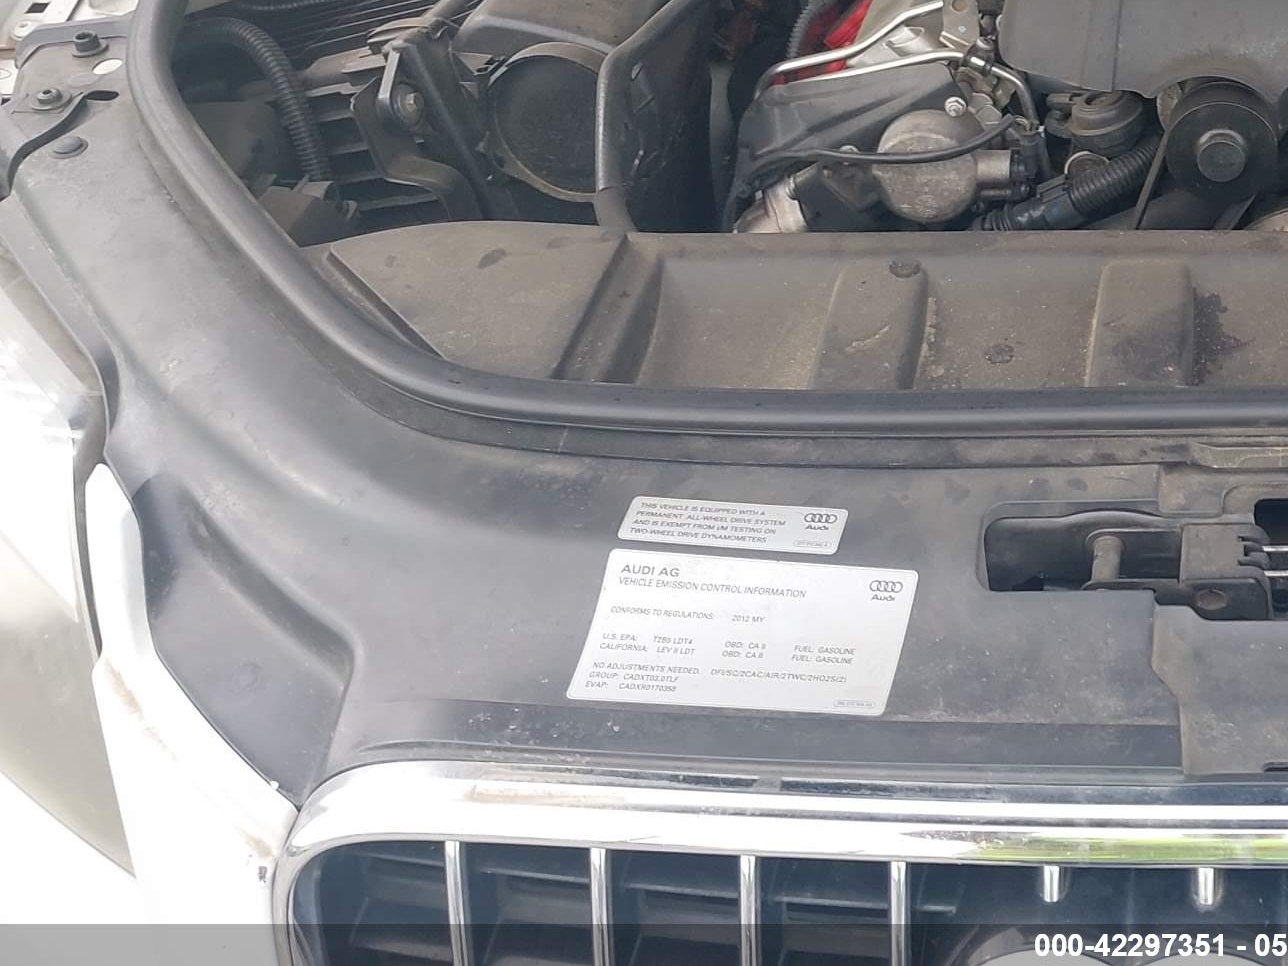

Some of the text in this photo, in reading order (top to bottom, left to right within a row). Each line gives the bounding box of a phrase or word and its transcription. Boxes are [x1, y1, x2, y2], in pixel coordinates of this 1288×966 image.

[636, 511, 683, 519] PERMANENT
[630, 528, 675, 536] TWO-WHEEL
[701, 533, 767, 543] DYNAMOMETERS
[621, 564, 680, 577] AUDI AG
[619, 577, 807, 598] VEHICLE EMISSION CONTROL INFORMATION
[610, 606, 651, 616] CONFORMS
[818, 646, 856, 655] GASOLINE
[815, 656, 853, 664] GASOLINE
[606, 662, 665, 672] ADJUSTMENTS
